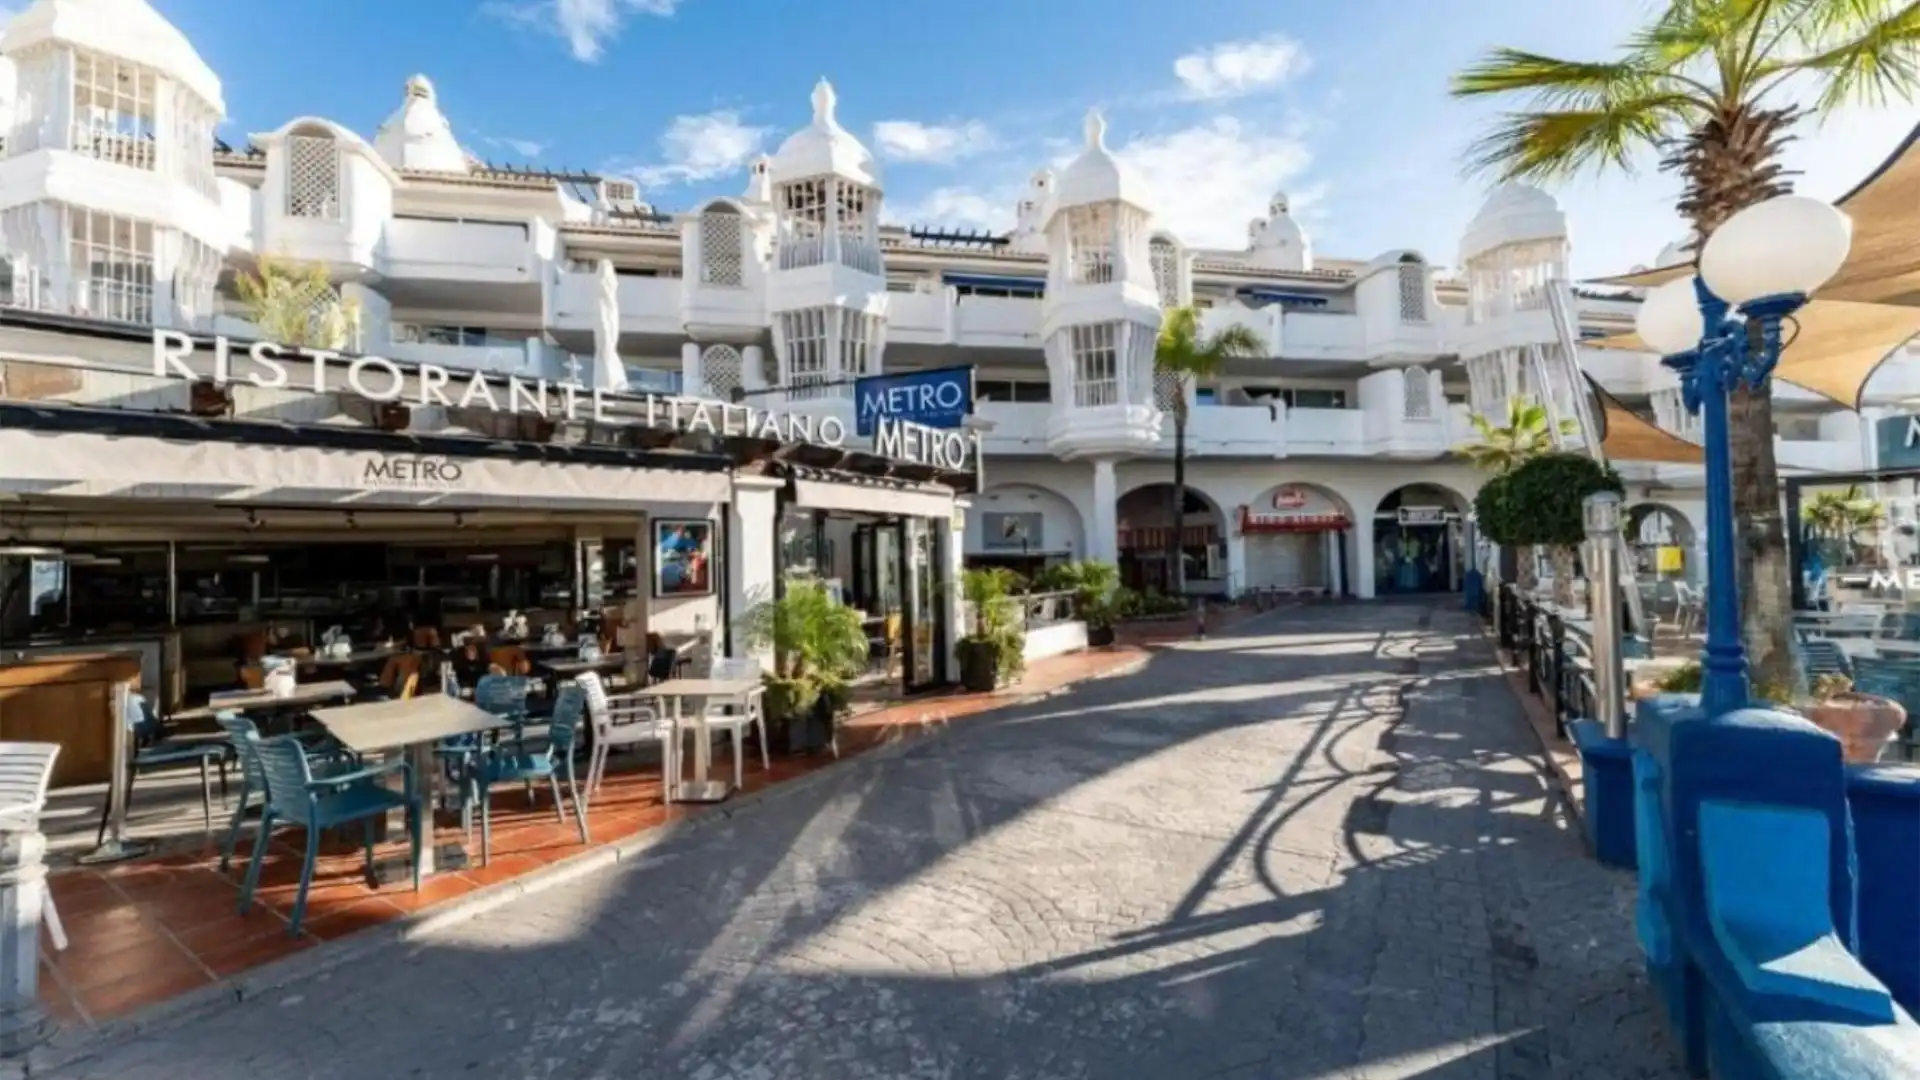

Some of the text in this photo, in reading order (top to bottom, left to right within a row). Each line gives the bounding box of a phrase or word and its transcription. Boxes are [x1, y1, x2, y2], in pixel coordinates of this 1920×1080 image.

[153, 329, 845, 446] RISTORANTE ITALIANO
[862, 381, 962, 416] METRO
[876, 414, 964, 469] METRO
[364, 458, 462, 481] METRO
